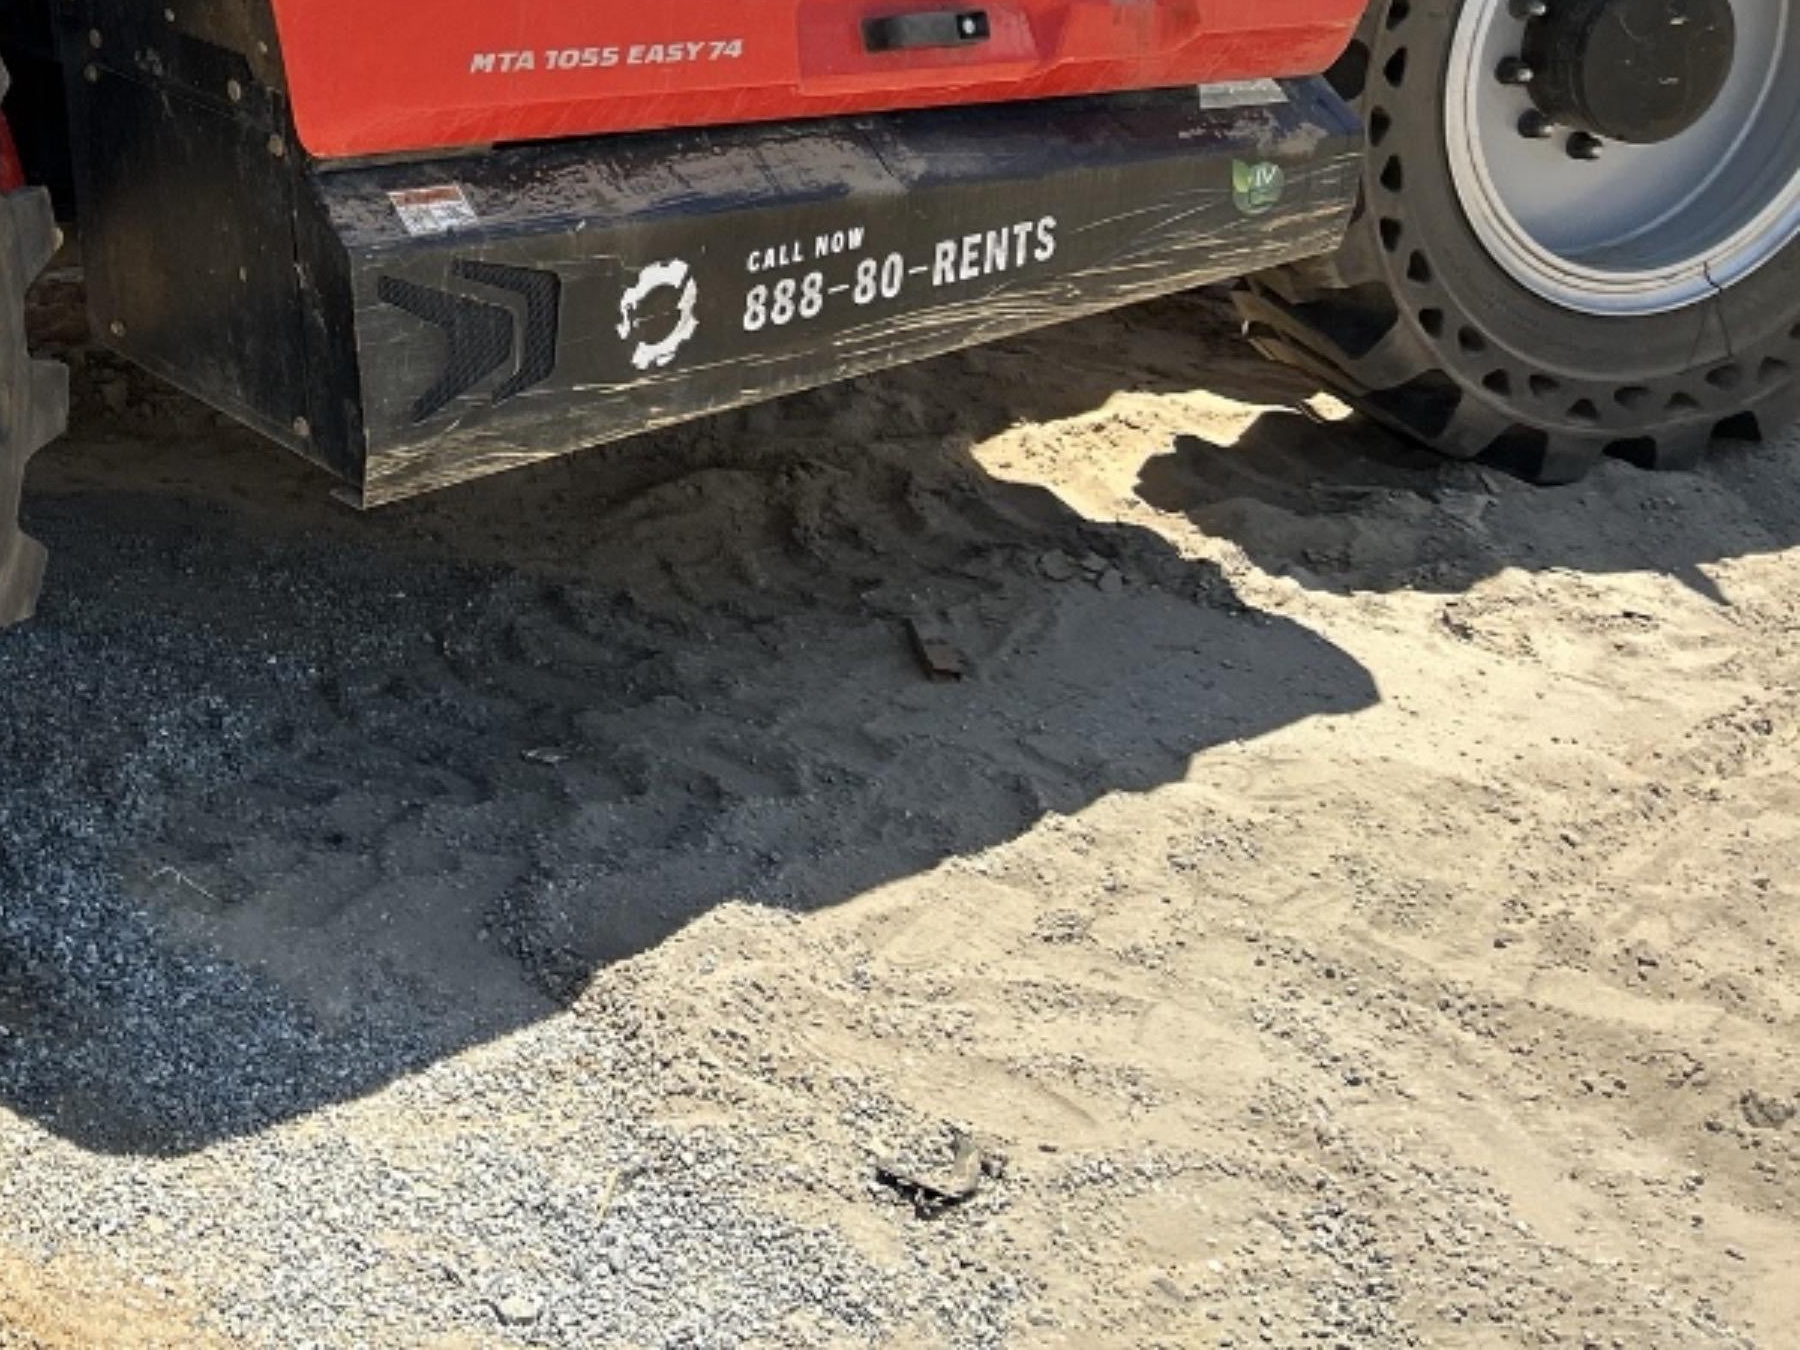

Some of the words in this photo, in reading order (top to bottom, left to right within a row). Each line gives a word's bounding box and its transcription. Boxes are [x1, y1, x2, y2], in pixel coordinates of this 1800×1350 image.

[469, 51, 535, 73] MTA
[544, 47, 619, 70] 1055
[626, 42, 705, 65] EASY
[708, 38, 745, 61] 74
[746, 240, 804, 273] CALL
[814, 226, 866, 259] NOW
[742, 215, 1057, 332] 888-80-RENTS
